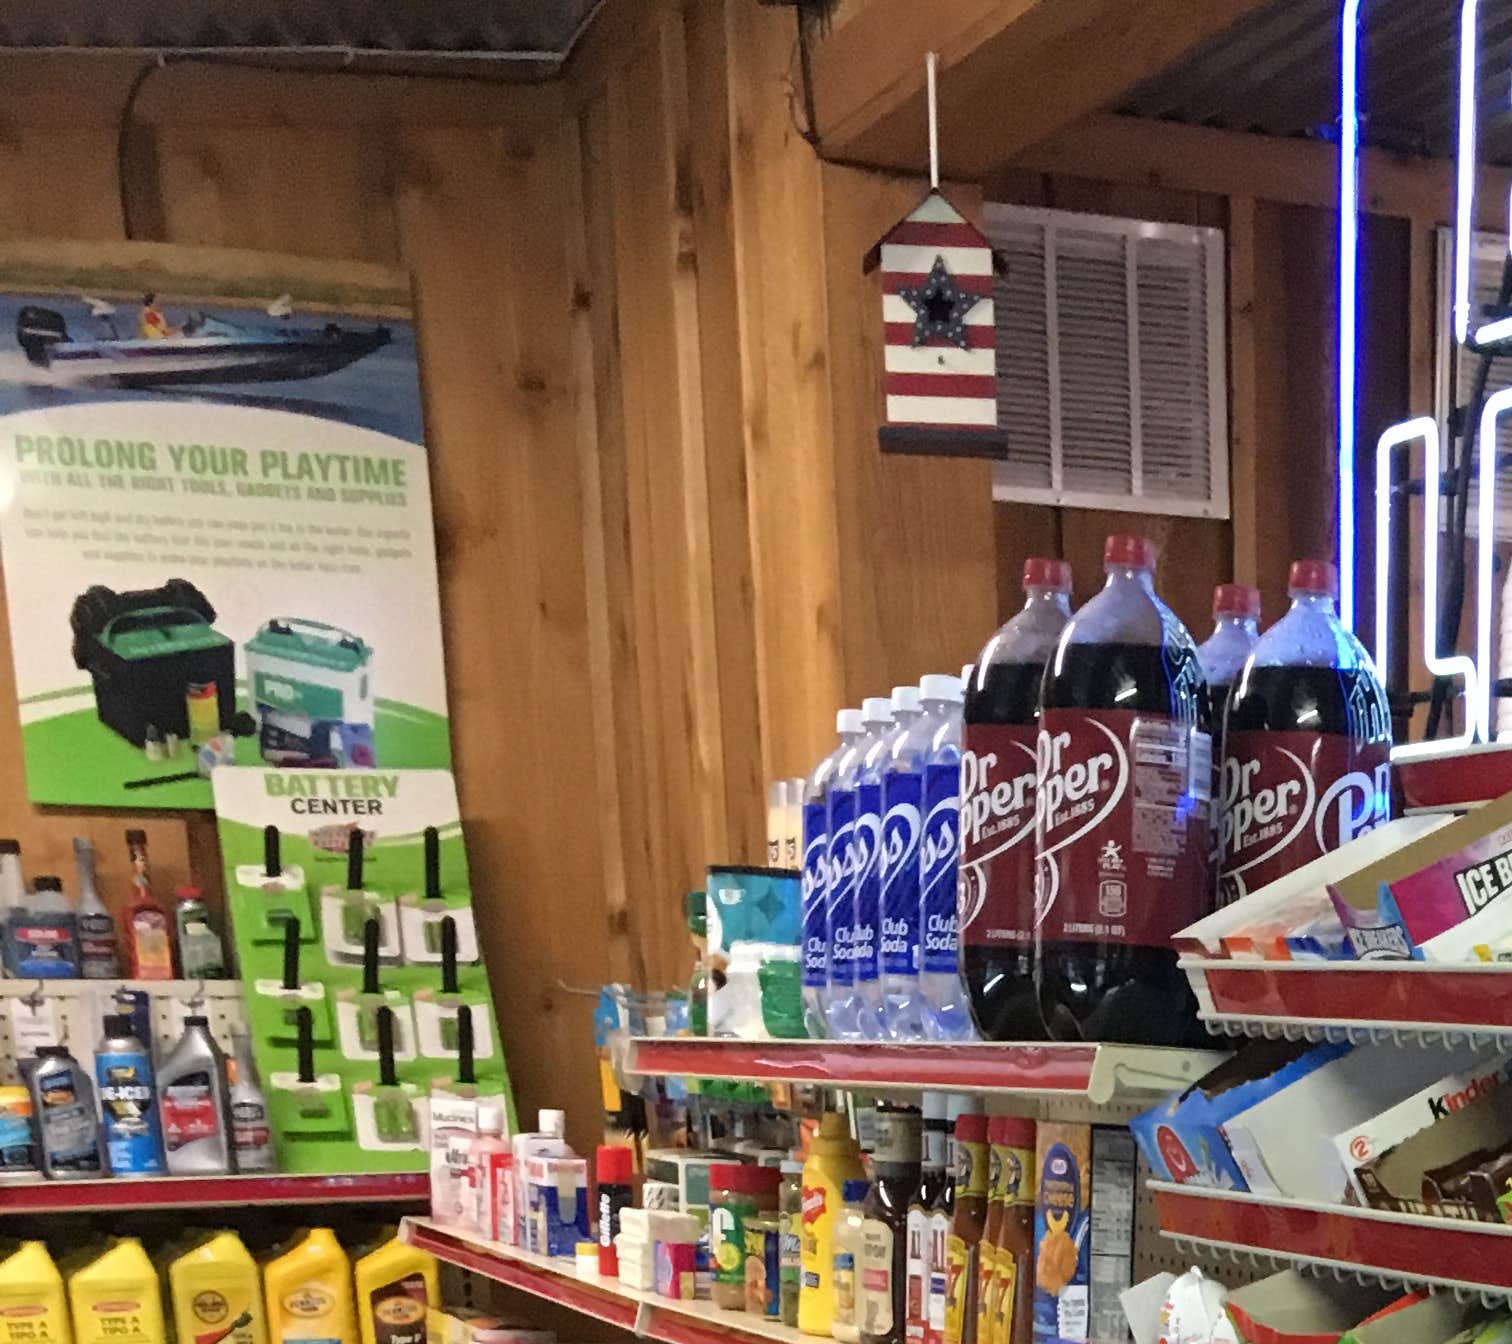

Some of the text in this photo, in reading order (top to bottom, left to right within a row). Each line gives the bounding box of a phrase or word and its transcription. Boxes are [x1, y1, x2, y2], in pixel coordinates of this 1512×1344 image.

[15, 434, 408, 487] PROLONG YOUR PLAYTIME
[67, 473, 92, 488] ALL
[132, 475, 174, 492] RIGHT
[236, 481, 302, 500] GADGETS
[307, 485, 336, 502] AND
[341, 488, 407, 507] SUPPLIES
[264, 773, 400, 799] BATTERY
[291, 799, 383, 816] CENTER
[1457, 866, 1500, 914] ICE
[882, 918, 908, 935] Club
[928, 915, 957, 933] Club
[880, 936, 907, 953] Soda
[925, 934, 957, 950] Soda
[1427, 1070, 1503, 1121] Kinder
[7, 1316, 48, 1328] TYPE A
[99, 1315, 140, 1327] TYPE A
[8, 1327, 49, 1339] TIPO A
[101, 1325, 142, 1337] TIPO A
